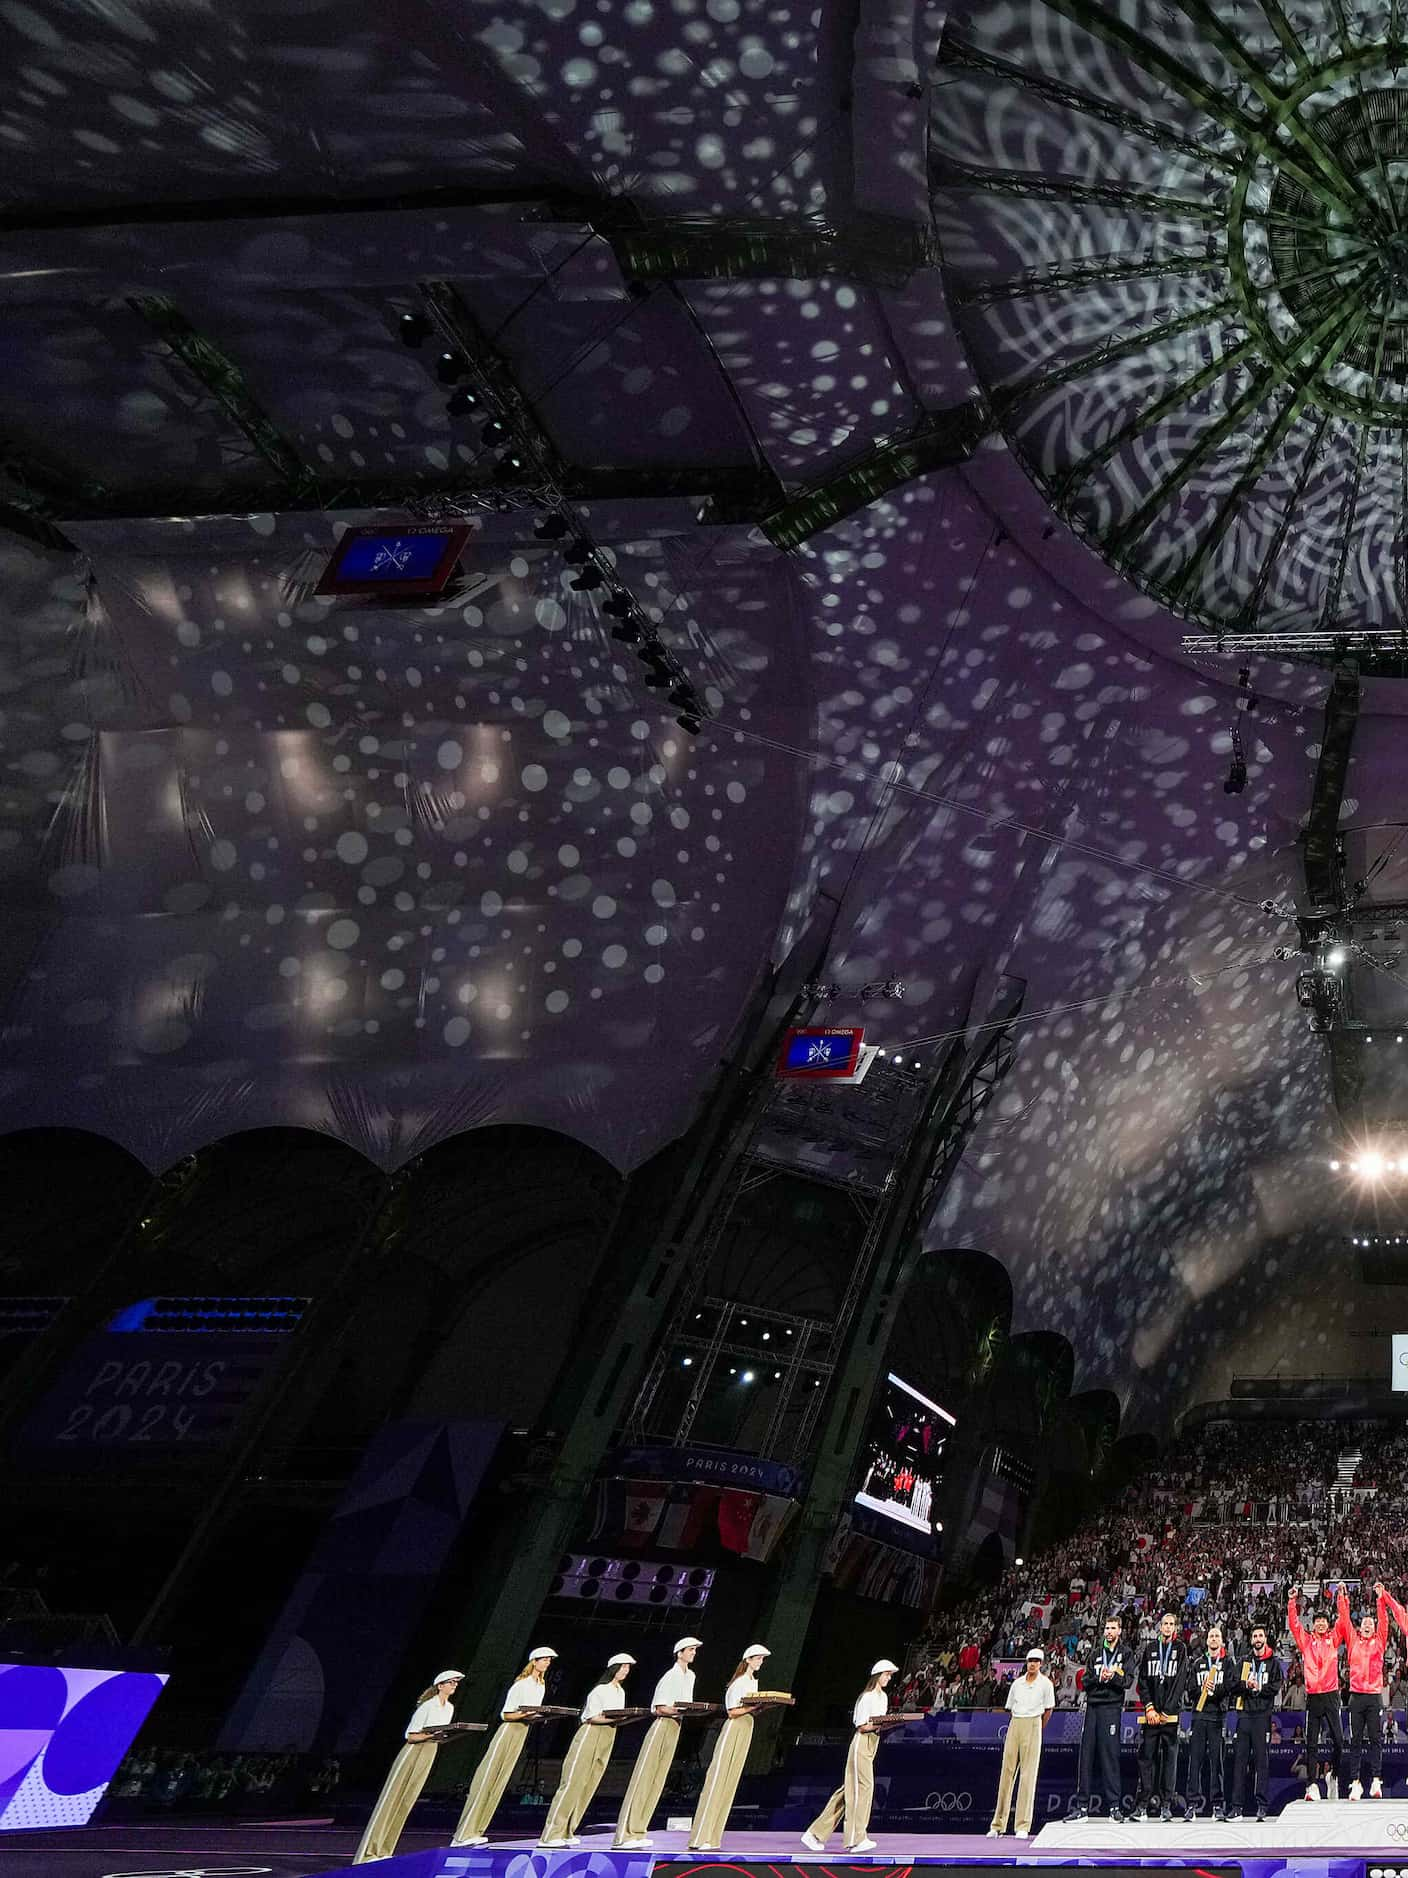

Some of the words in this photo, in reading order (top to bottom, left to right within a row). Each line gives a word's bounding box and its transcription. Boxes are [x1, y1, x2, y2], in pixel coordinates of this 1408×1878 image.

[85, 1360, 225, 1397] PARIS
[55, 1403, 196, 1441] 2024
[686, 1457, 728, 1472] PARIS
[729, 1463, 764, 1479] 2024
